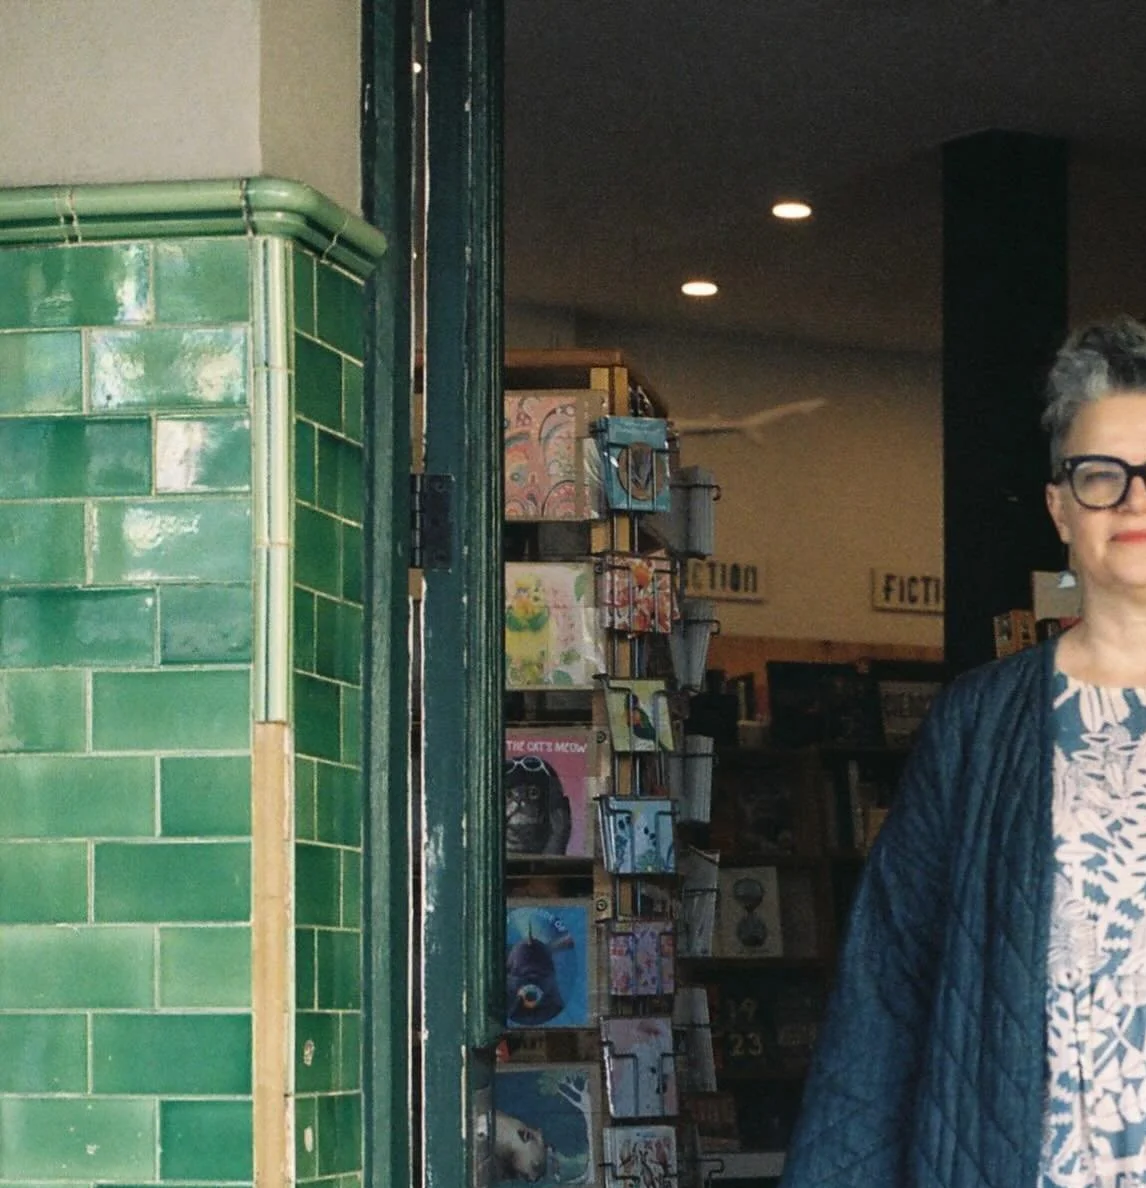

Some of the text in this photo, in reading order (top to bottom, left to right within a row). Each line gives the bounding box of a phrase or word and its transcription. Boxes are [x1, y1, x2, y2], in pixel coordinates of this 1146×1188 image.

[691, 561, 758, 593] CTION
[884, 572, 941, 605] FICTI
[505, 740, 525, 751] THE
[554, 741, 588, 754] MEOW
